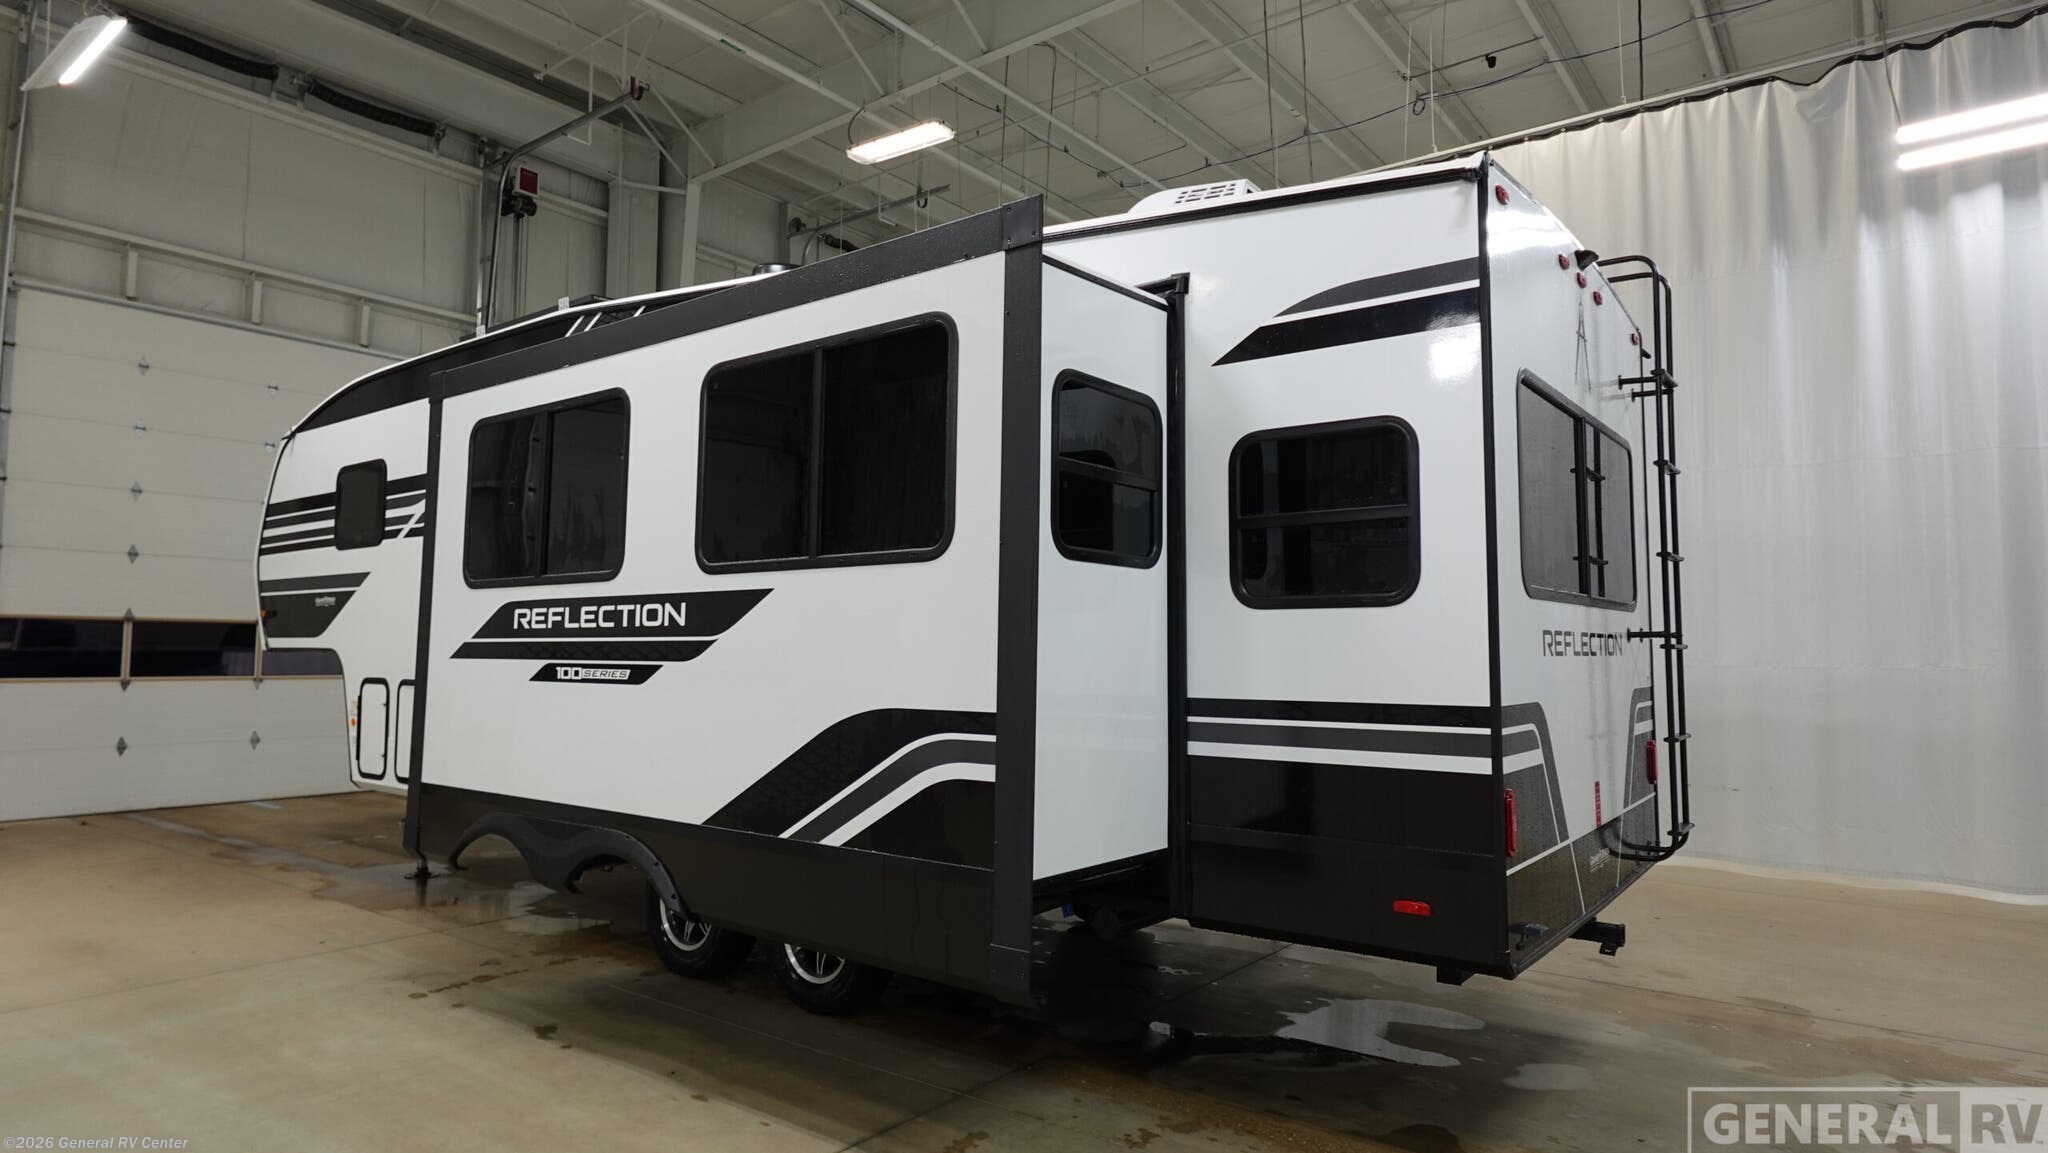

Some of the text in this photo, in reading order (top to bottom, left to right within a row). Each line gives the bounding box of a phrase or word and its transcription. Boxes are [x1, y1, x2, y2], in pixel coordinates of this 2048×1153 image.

[514, 602, 686, 629] REFLECTION
[1543, 630, 1622, 656] REFLECTION
[556, 667, 630, 679] 100 SERIES
